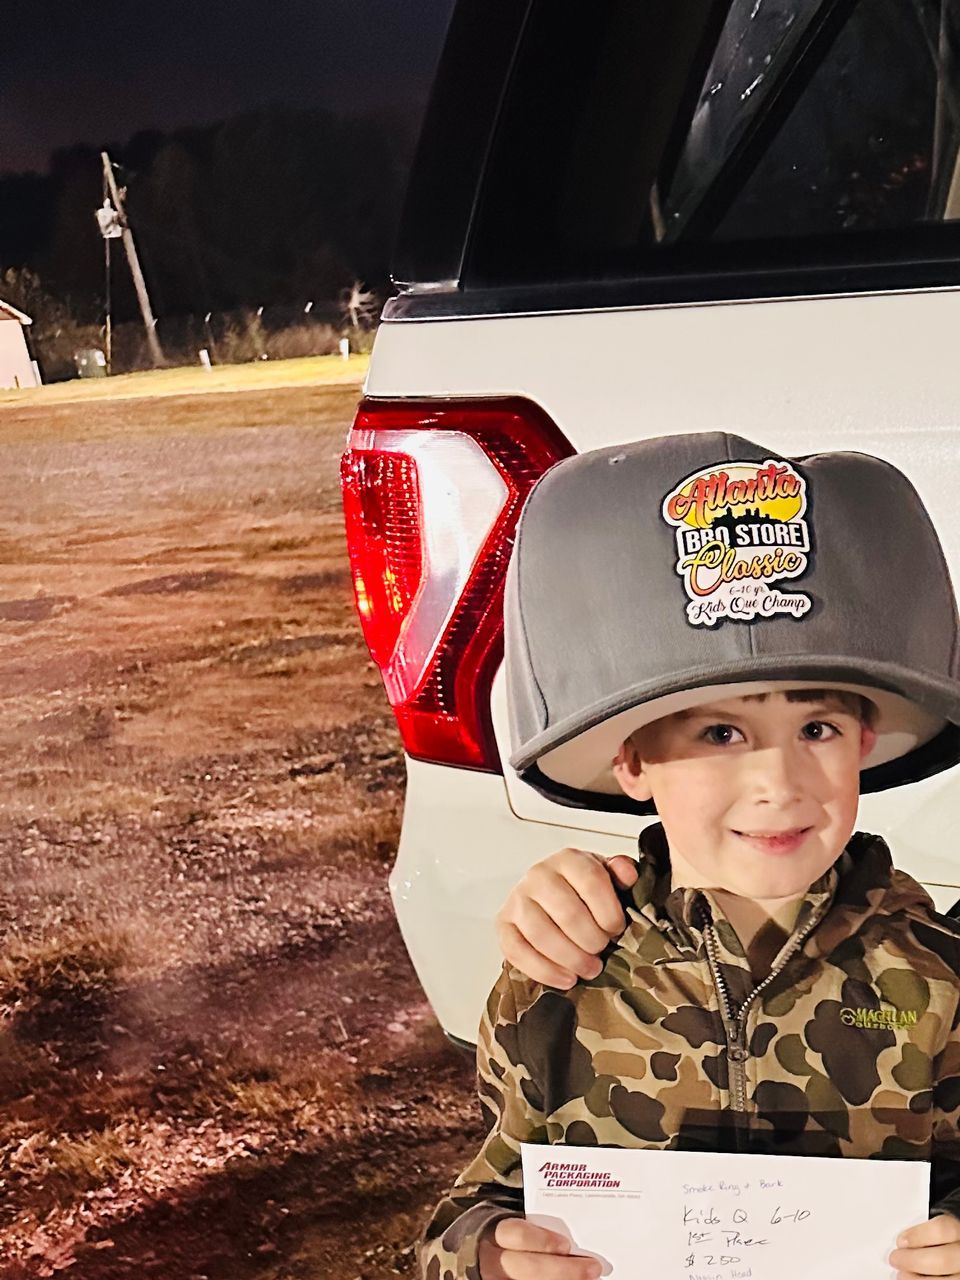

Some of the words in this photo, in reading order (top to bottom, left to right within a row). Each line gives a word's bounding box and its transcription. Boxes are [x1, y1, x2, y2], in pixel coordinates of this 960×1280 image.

[668, 463, 801, 528] Atlanta
[735, 523, 803, 546] STORE
[682, 540, 802, 597] Classic
[691, 600, 726, 620] Kids
[730, 597, 759, 615] Que
[762, 595, 806, 614] Champ
[856, 1007, 917, 1024] MAGELLAN
[538, 1162, 587, 1172] ARMOR
[543, 1171, 611, 1180] PACKAGING
[546, 1179, 621, 1188] CORPORATION
[720, 1181, 742, 1196] Ring
[759, 1179, 783, 1188] Bark
[683, 1205, 721, 1226] Kids
[732, 1208, 748, 1224] Q
[770, 1206, 811, 1225] 6-10
